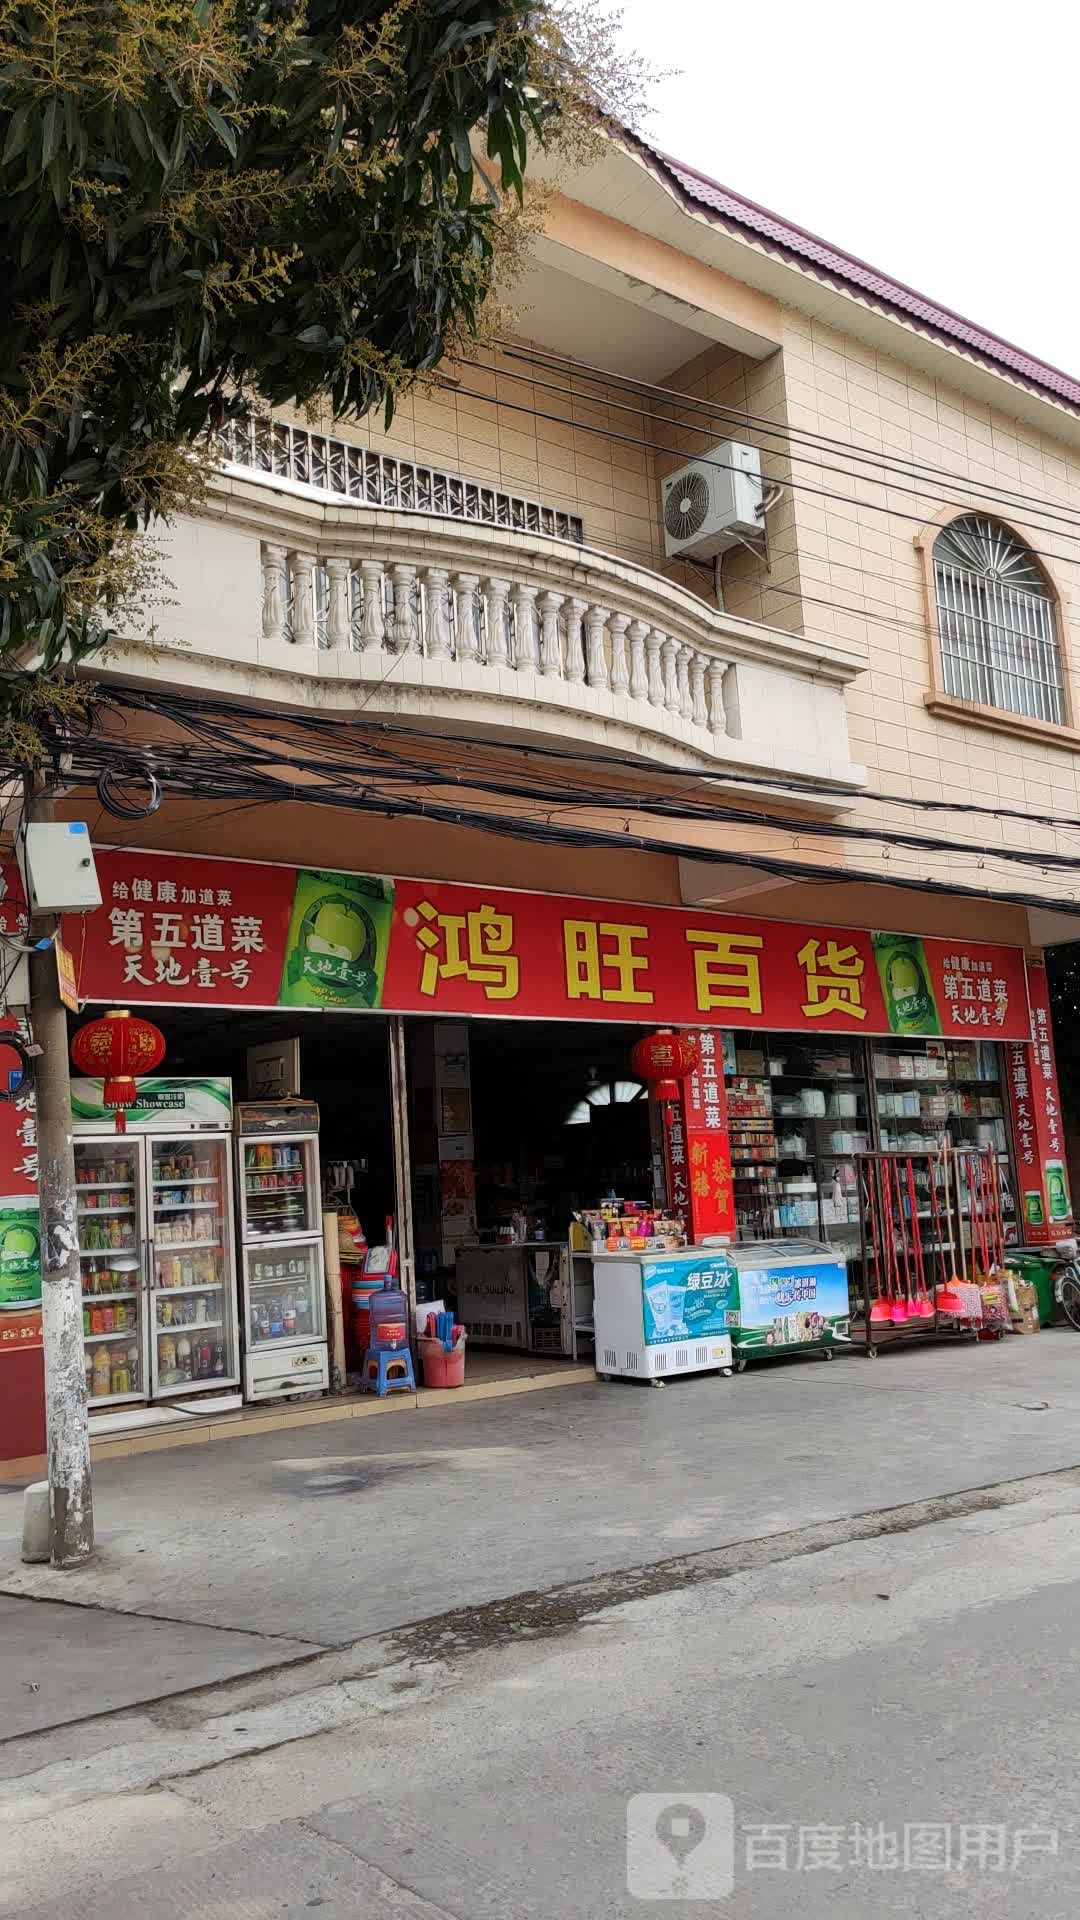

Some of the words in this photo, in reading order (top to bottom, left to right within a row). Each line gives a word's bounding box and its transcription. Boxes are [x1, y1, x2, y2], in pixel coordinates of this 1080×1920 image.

[112, 878, 233, 907] 给健康加道菜
[108, 907, 264, 954] 第五道菜
[122, 954, 253, 989] 天地壹号
[302, 956, 368, 987] 天地壹号
[415, 901, 868, 1020] 鸿旺百货
[943, 973, 1009, 1005] 第五道菜
[951, 1004, 1006, 1026] 天地壹号
[699, 1032, 721, 1128] 第五道菜
[1036, 1007, 1054, 1079] 第五道菜
[1045, 1087, 1060, 1153] 天地壹号
[136, 1098, 185, 1109] Showcase
[1017, 1103, 1035, 1165] 天地壹号
[687, 1269, 733, 1291] 绿豆冰
